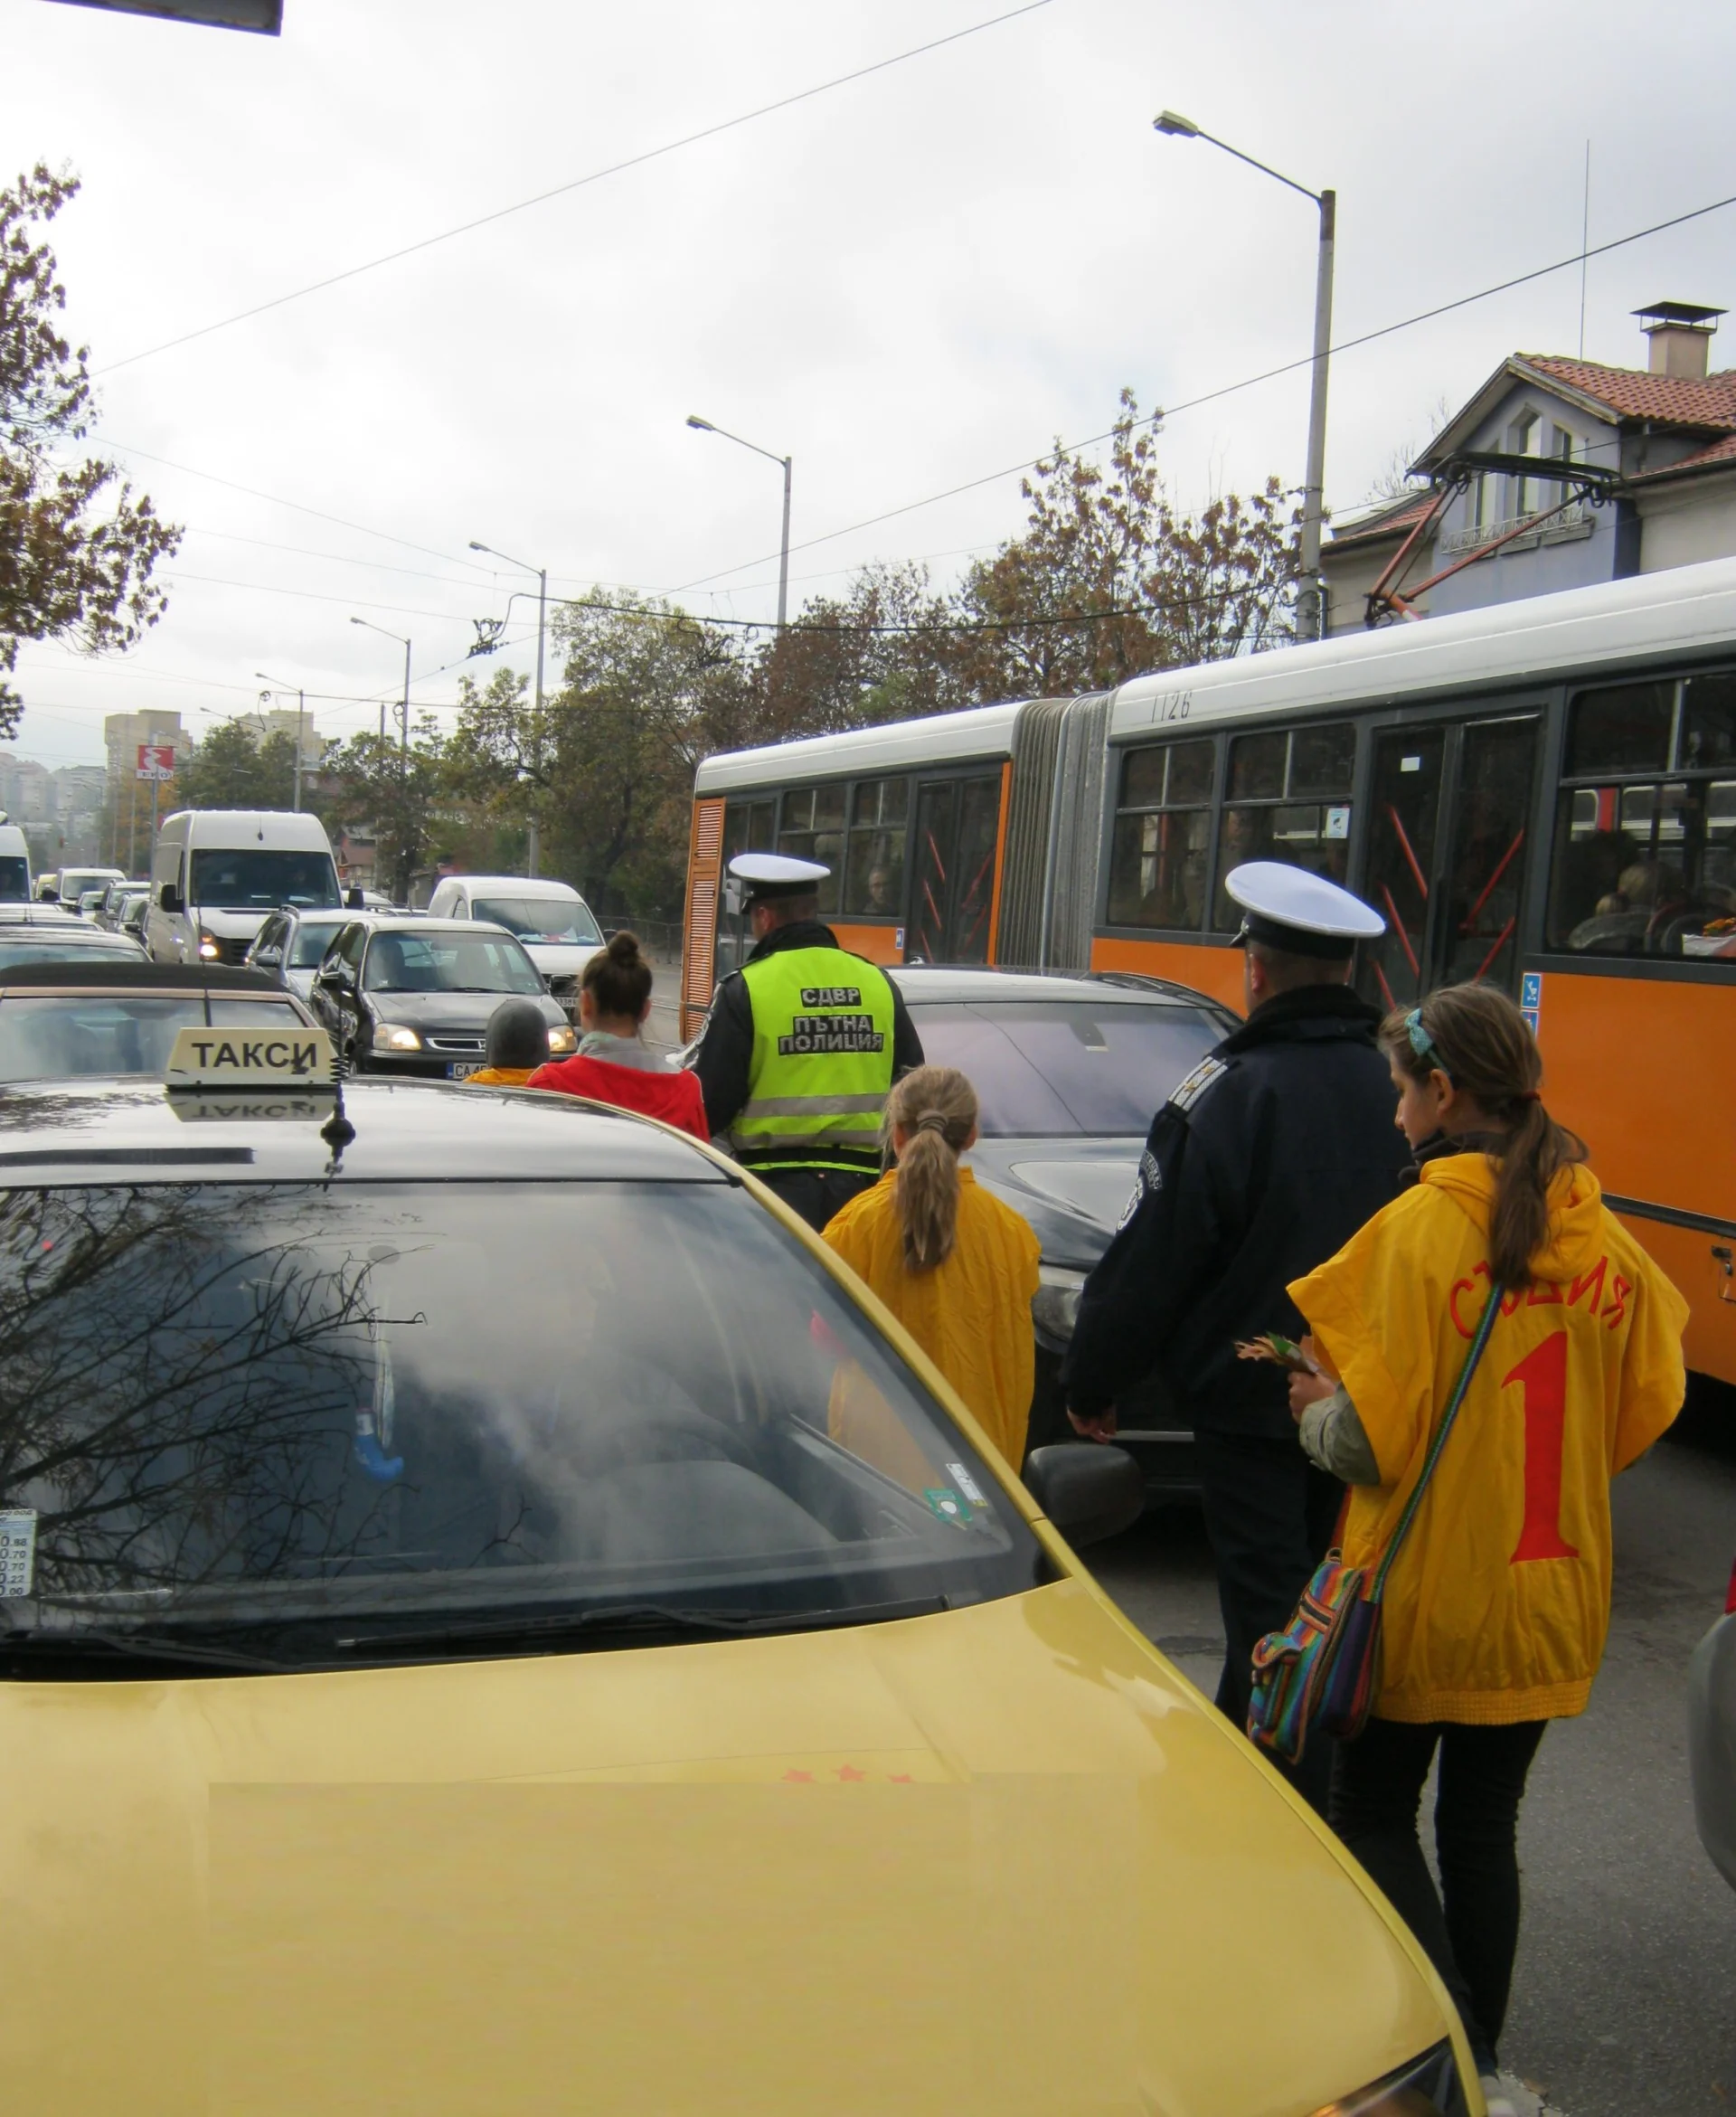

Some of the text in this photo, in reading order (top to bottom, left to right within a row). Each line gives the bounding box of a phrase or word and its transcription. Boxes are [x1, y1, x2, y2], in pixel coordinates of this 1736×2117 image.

[1151, 690, 1193, 723] 1126
[801, 988, 860, 1007] СДВР
[795, 1016, 873, 1033] ПЪТНА
[192, 1042, 316, 1068] ТАКСИ
[779, 1034, 882, 1054] ПОЛИЦИЯ
[1501, 1330, 1580, 1565] 1
